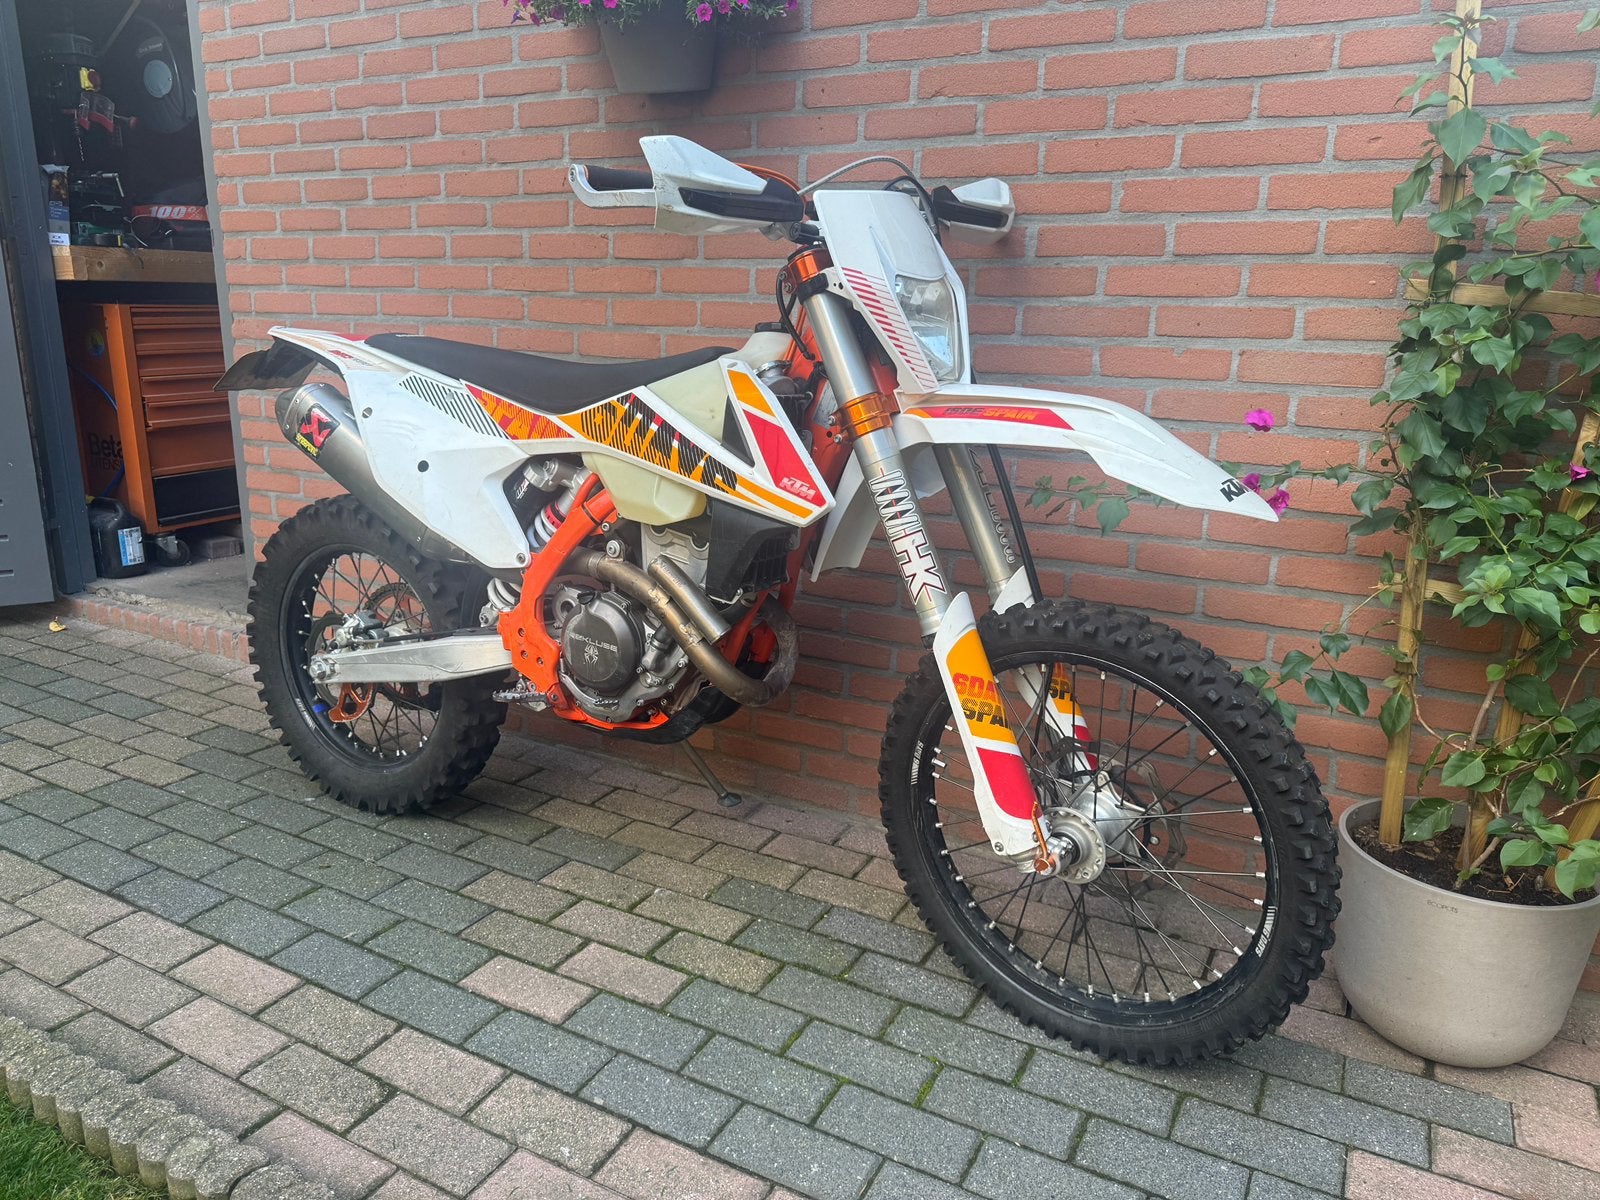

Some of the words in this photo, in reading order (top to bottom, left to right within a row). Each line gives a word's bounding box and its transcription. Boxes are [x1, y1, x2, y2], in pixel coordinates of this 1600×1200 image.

[150, 206, 201, 220] 100%
[983, 408, 1038, 420] SPAIN
[779, 476, 816, 500] KTM
[1255, 934, 1268, 957] DAYS
